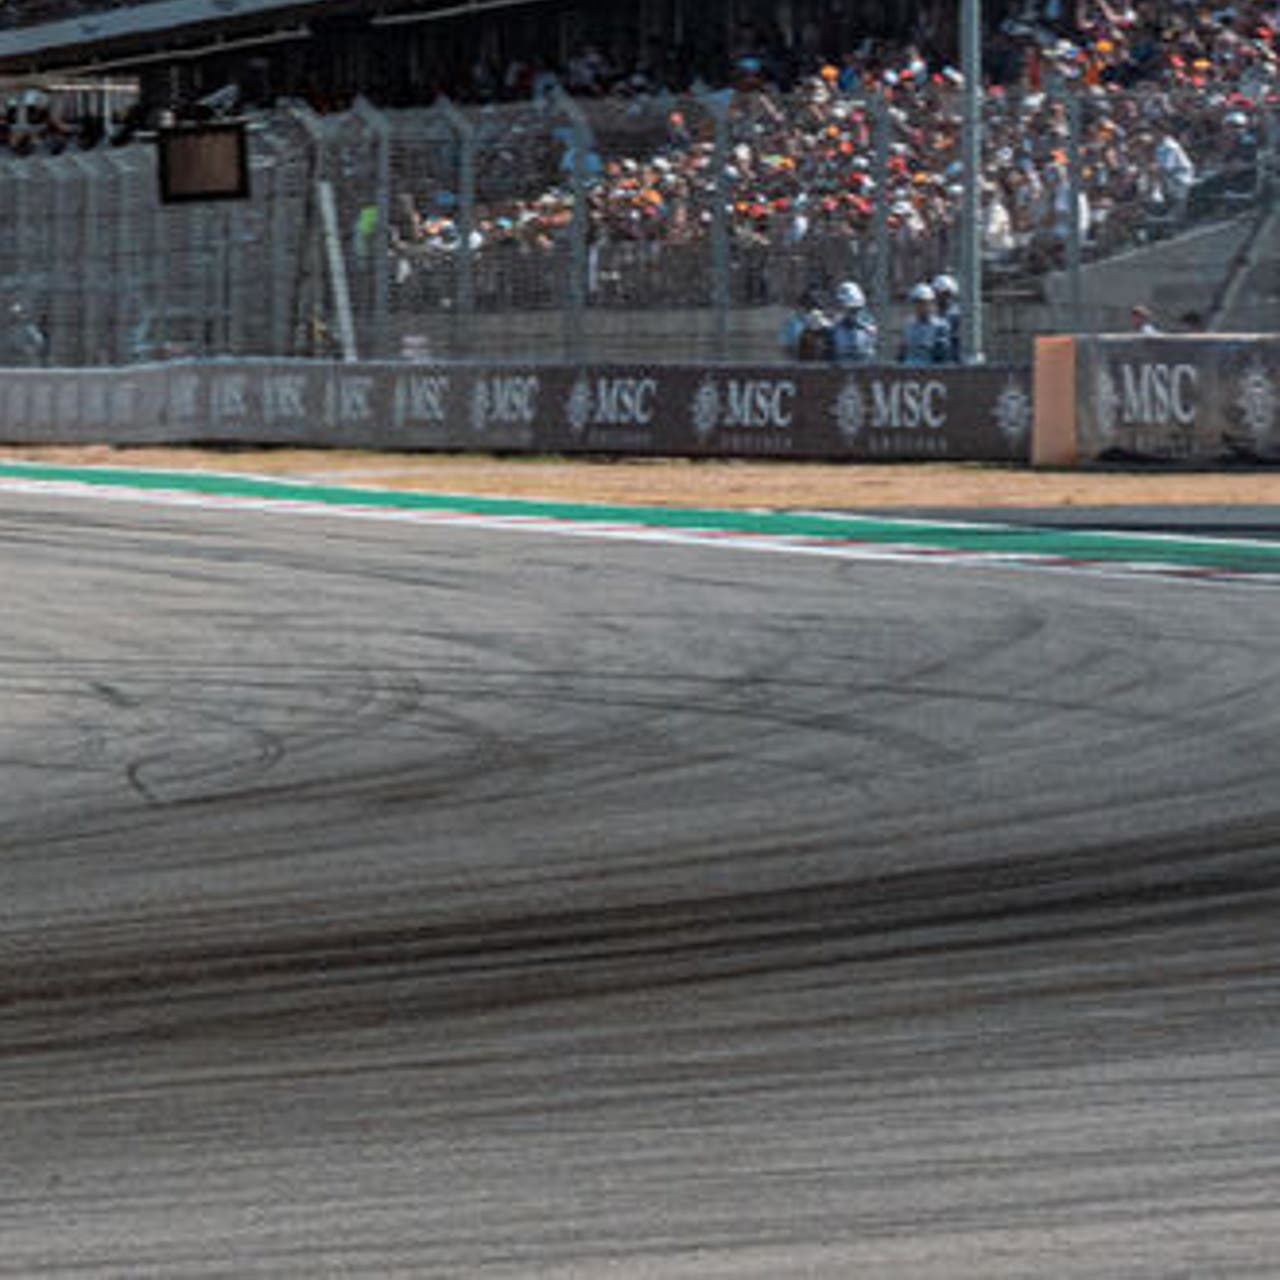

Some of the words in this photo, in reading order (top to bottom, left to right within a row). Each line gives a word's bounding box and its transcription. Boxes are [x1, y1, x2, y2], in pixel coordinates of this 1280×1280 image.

[593, 377, 658, 424] MSC
[723, 378, 796, 427] MSC
[870, 379, 948, 429] MSC
[1119, 362, 1197, 424] MSC
